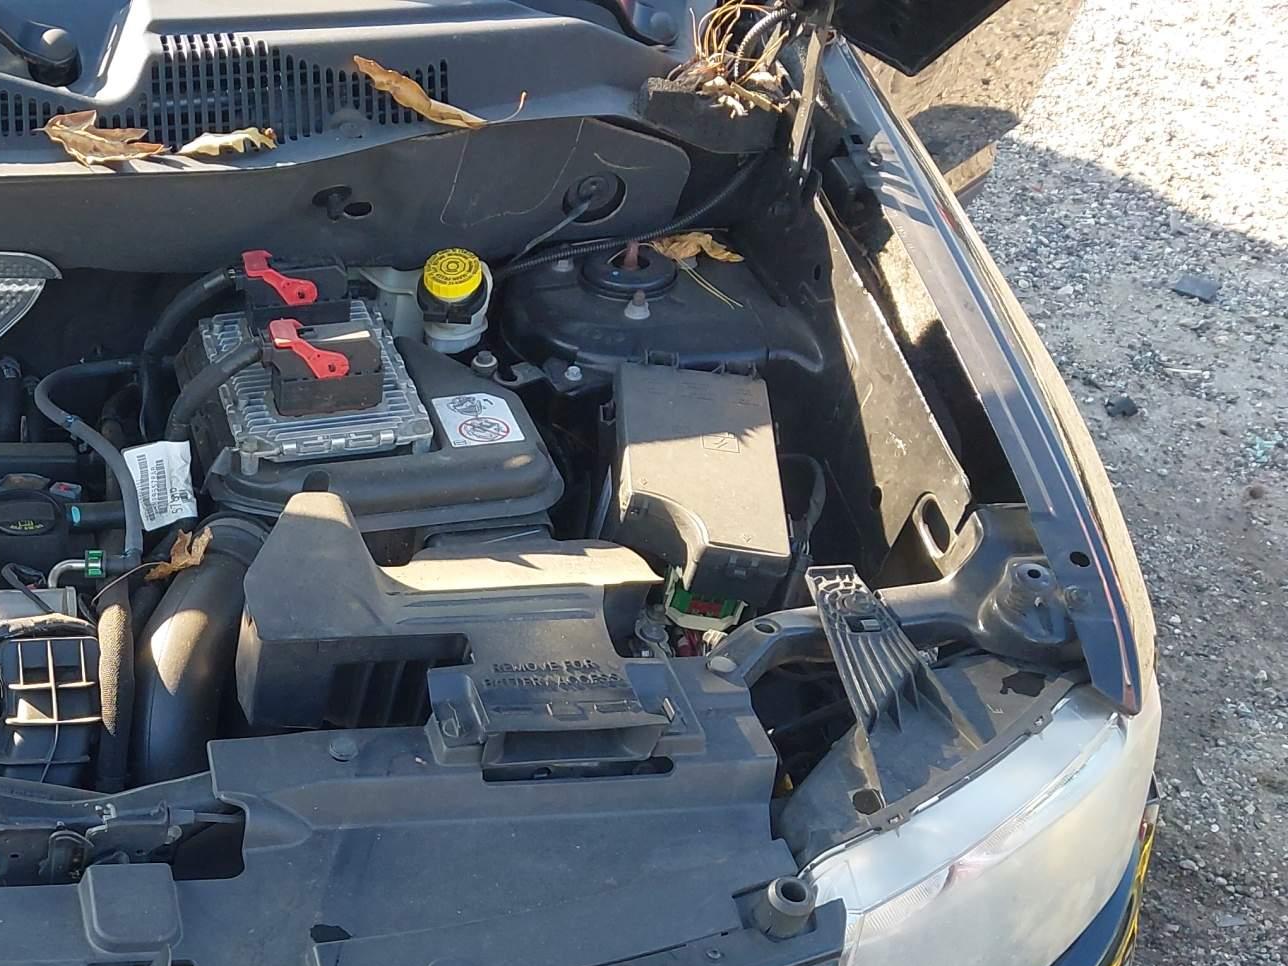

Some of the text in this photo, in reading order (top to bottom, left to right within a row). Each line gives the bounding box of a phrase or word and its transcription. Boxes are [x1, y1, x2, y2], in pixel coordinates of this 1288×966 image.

[492, 659, 595, 673] REMOVE FOR
[483, 673, 620, 688] BATTERY ACCESS
